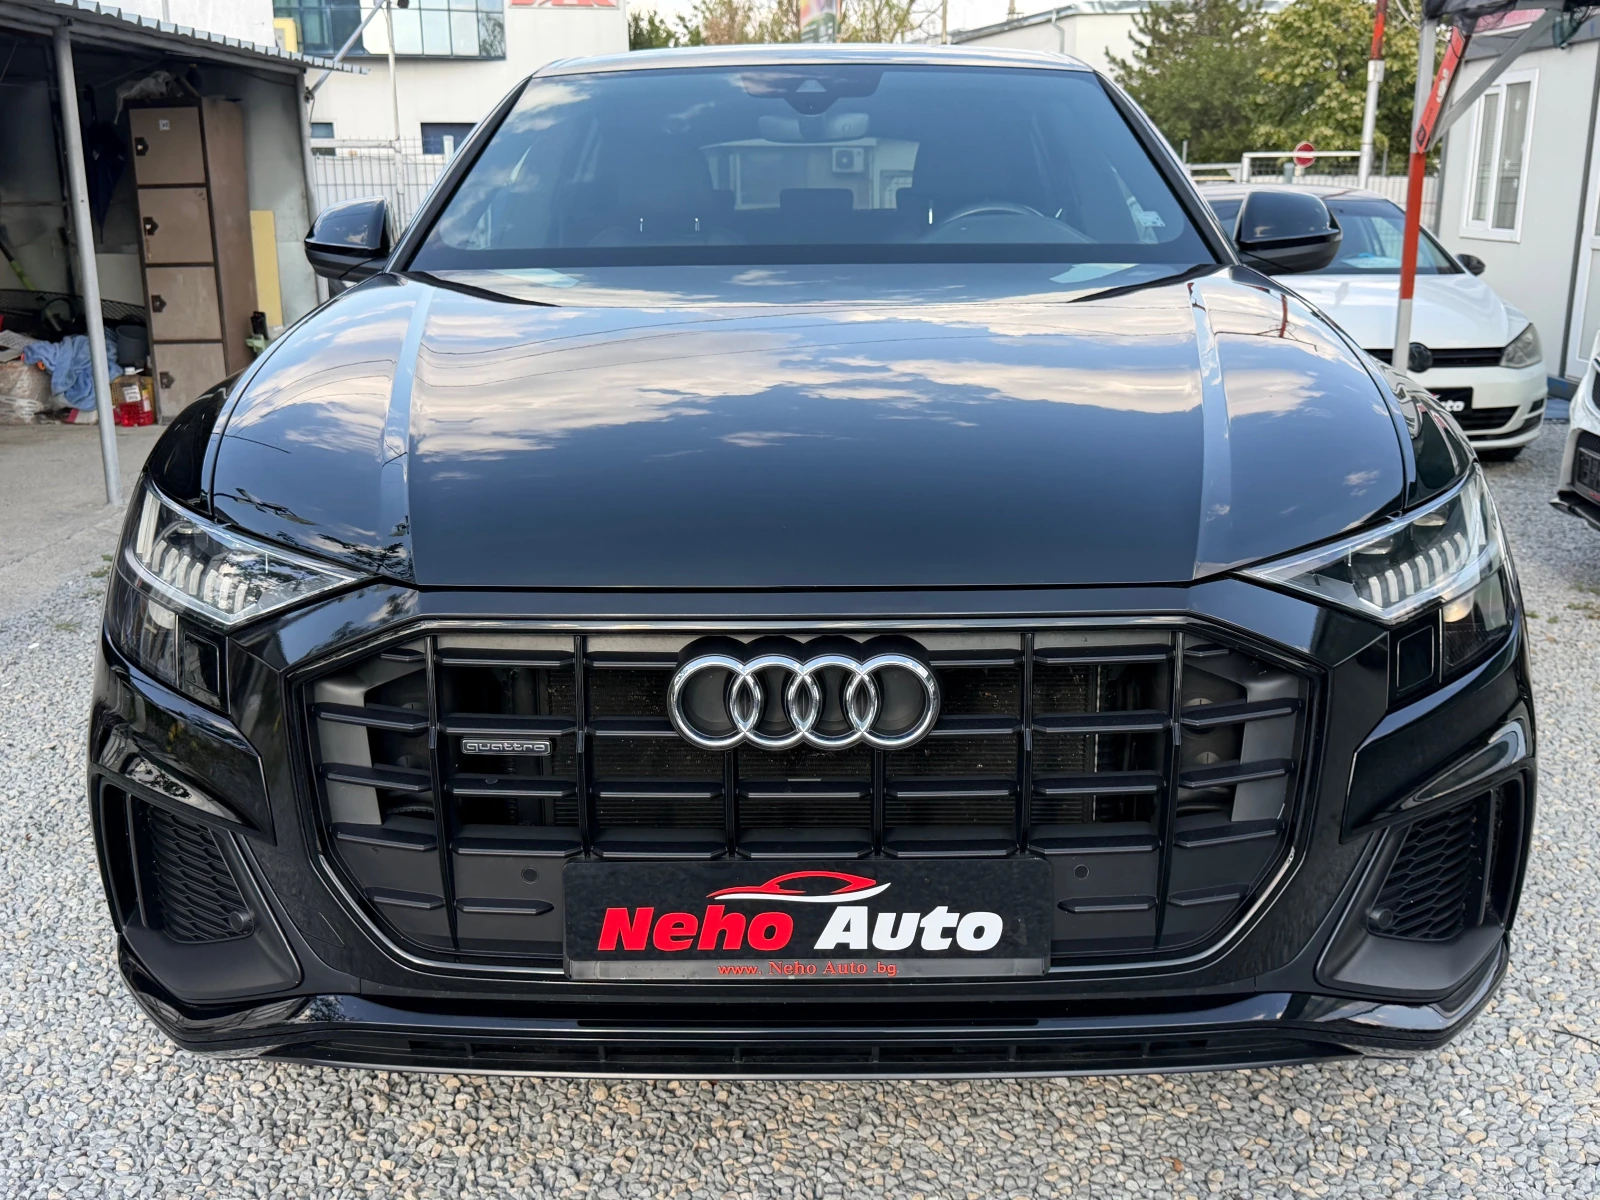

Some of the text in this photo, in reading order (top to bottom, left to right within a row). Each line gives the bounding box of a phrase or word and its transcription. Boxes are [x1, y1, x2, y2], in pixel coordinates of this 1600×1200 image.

[466, 742, 546, 752] quattro
[598, 905, 1004, 952] Neho Auto
[717, 965, 763, 975] www.
[768, 961, 817, 975] Neho
[822, 960, 868, 975] Auto
